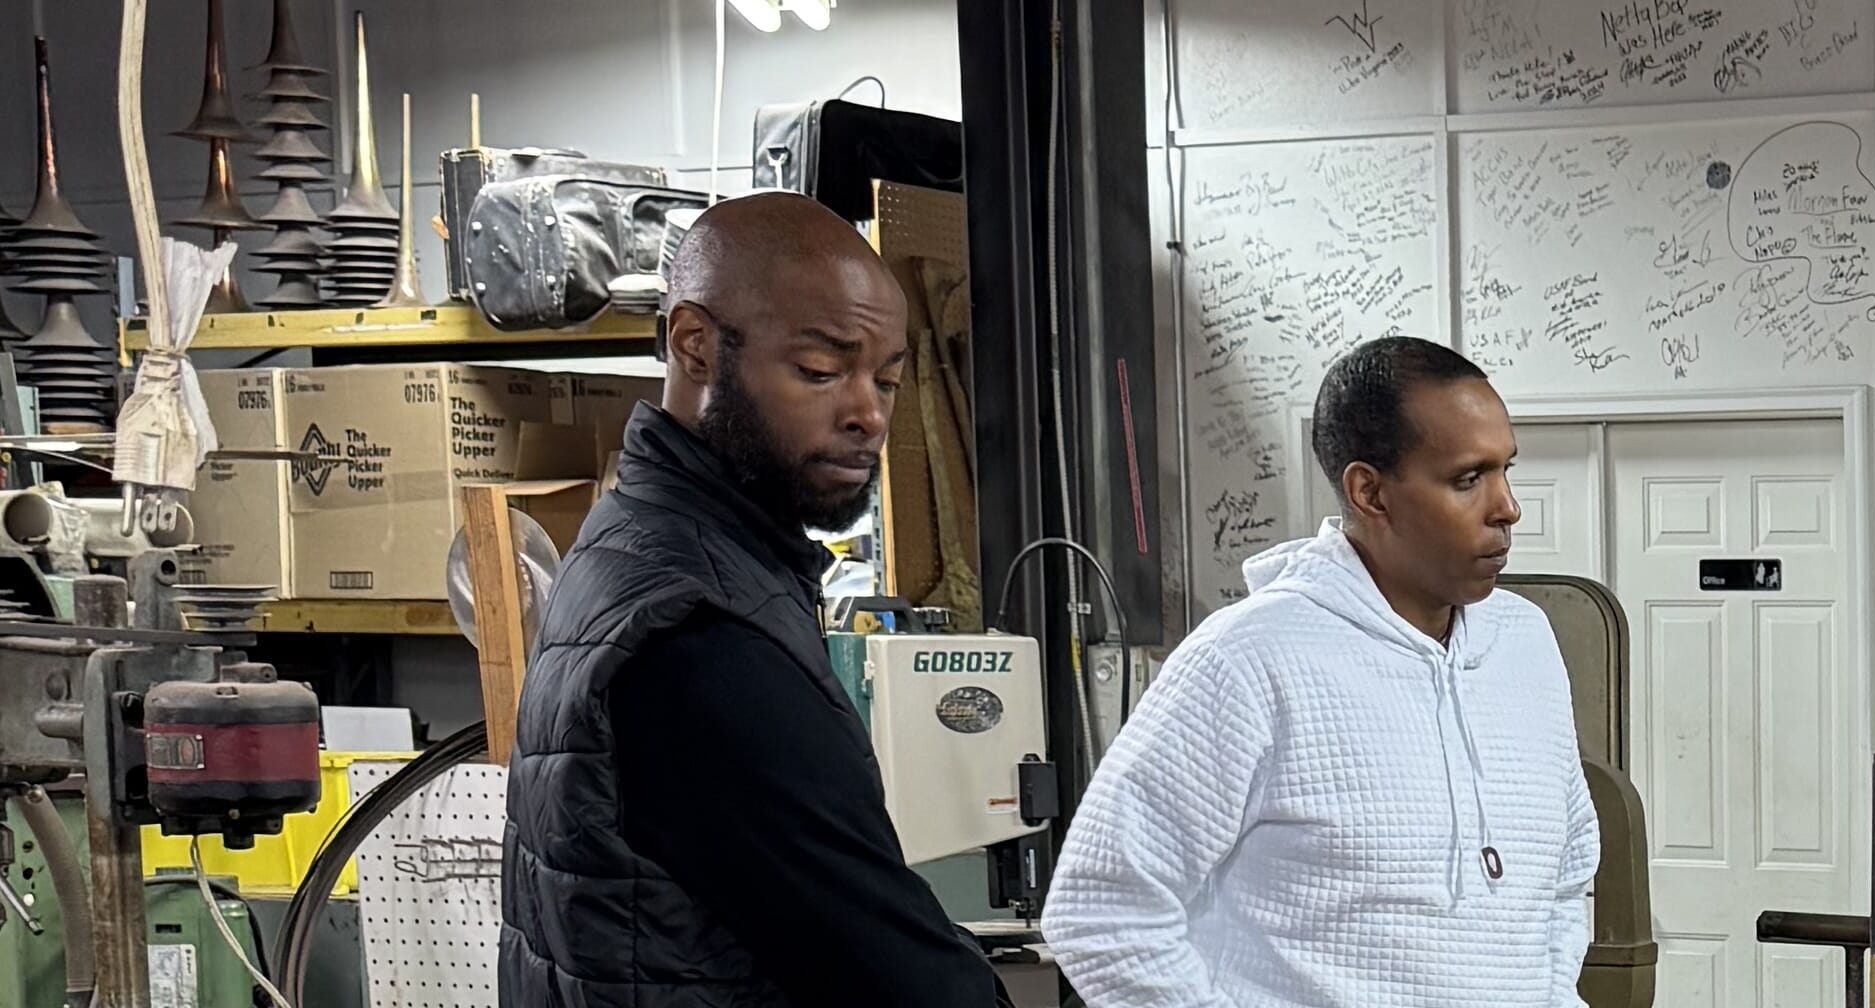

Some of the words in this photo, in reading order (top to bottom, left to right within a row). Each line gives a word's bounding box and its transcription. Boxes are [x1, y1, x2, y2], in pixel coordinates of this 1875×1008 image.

[451, 397, 476, 411] The
[451, 412, 506, 428] Quicker
[345, 429, 367, 444] The
[452, 427, 495, 442] Picker
[346, 444, 392, 458] Quicker
[452, 442, 496, 459] Upper
[348, 460, 383, 473] Picker
[348, 476, 384, 491] Upper
